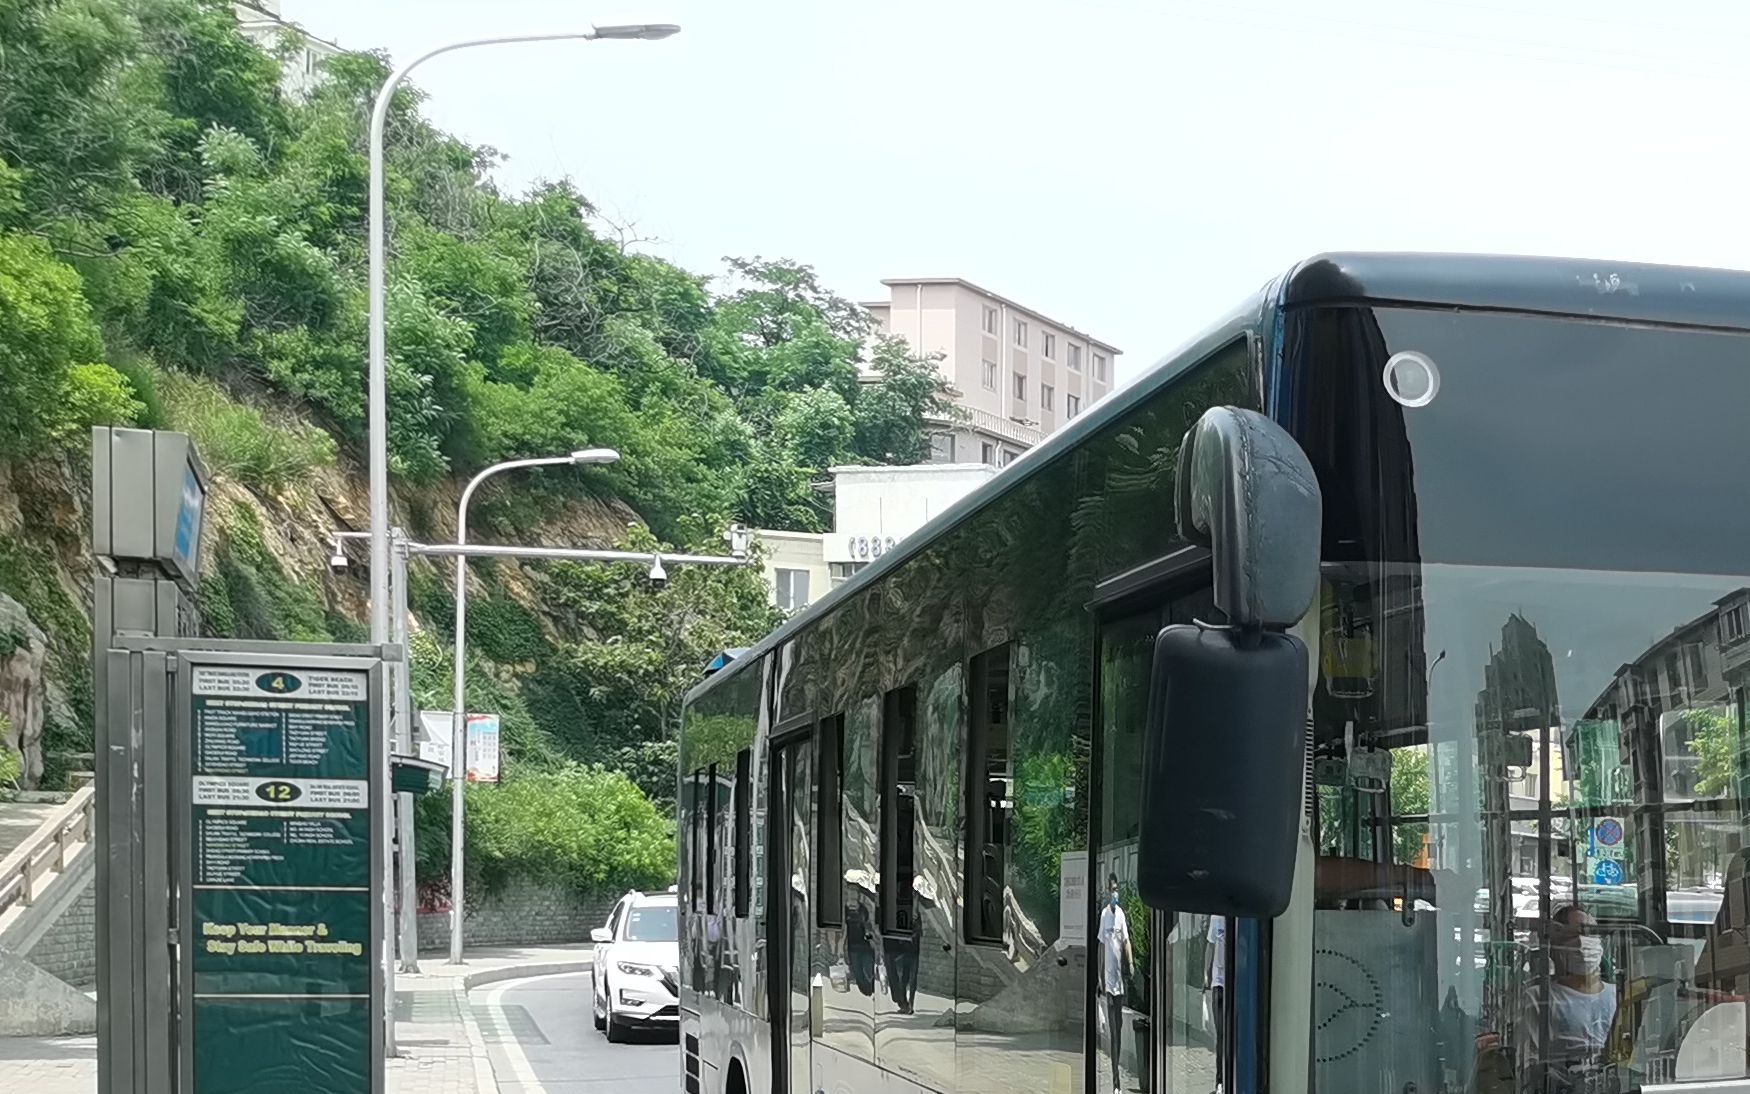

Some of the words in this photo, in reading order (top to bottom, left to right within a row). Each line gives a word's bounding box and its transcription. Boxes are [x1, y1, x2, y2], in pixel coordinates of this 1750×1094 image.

[271, 676, 284, 690] 4
[265, 785, 292, 799] 12
[202, 922, 236, 938] Keep
[237, 922, 268, 936] Your
[206, 939, 237, 955] Stay
[237, 940, 267, 954] Safe
[267, 940, 304, 954] While
[304, 940, 363, 956] Traveling
